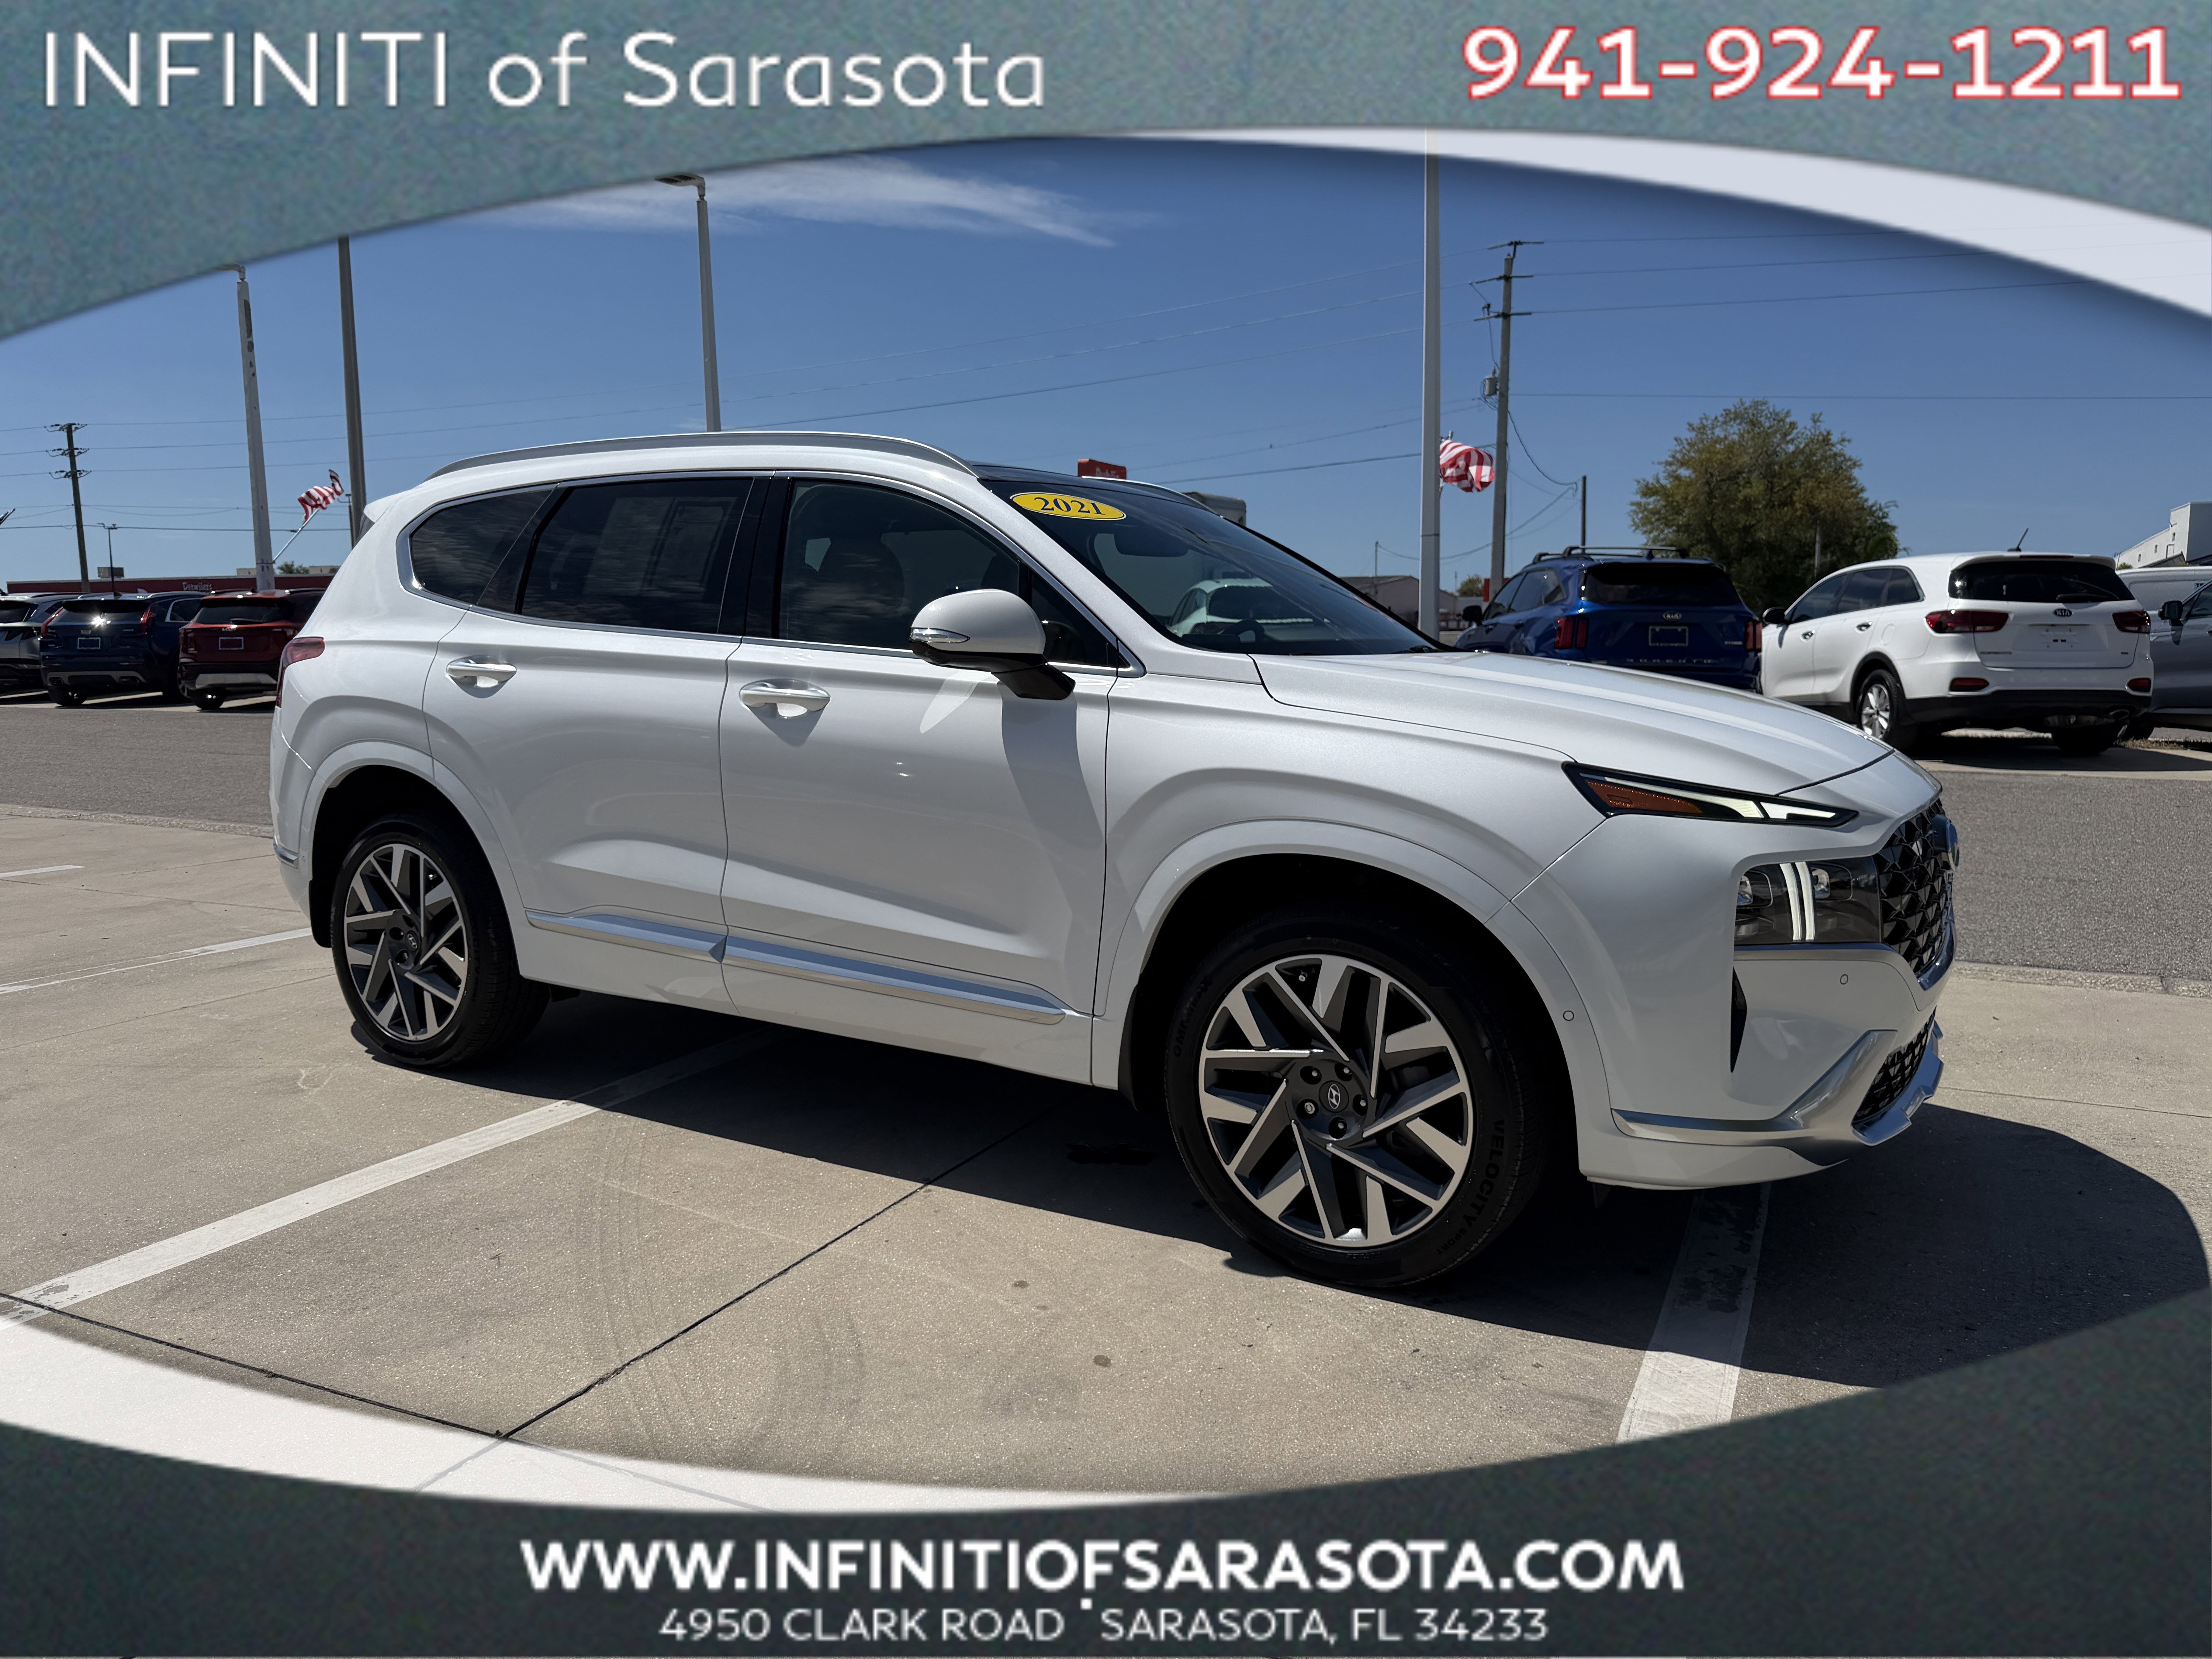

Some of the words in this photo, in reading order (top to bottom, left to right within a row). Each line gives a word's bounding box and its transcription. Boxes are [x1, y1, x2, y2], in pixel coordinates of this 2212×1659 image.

[1034, 497, 1106, 515] 2021
[1462, 1119, 1505, 1228] VELOCITY
[1436, 1227, 1467, 1255] SPORT
